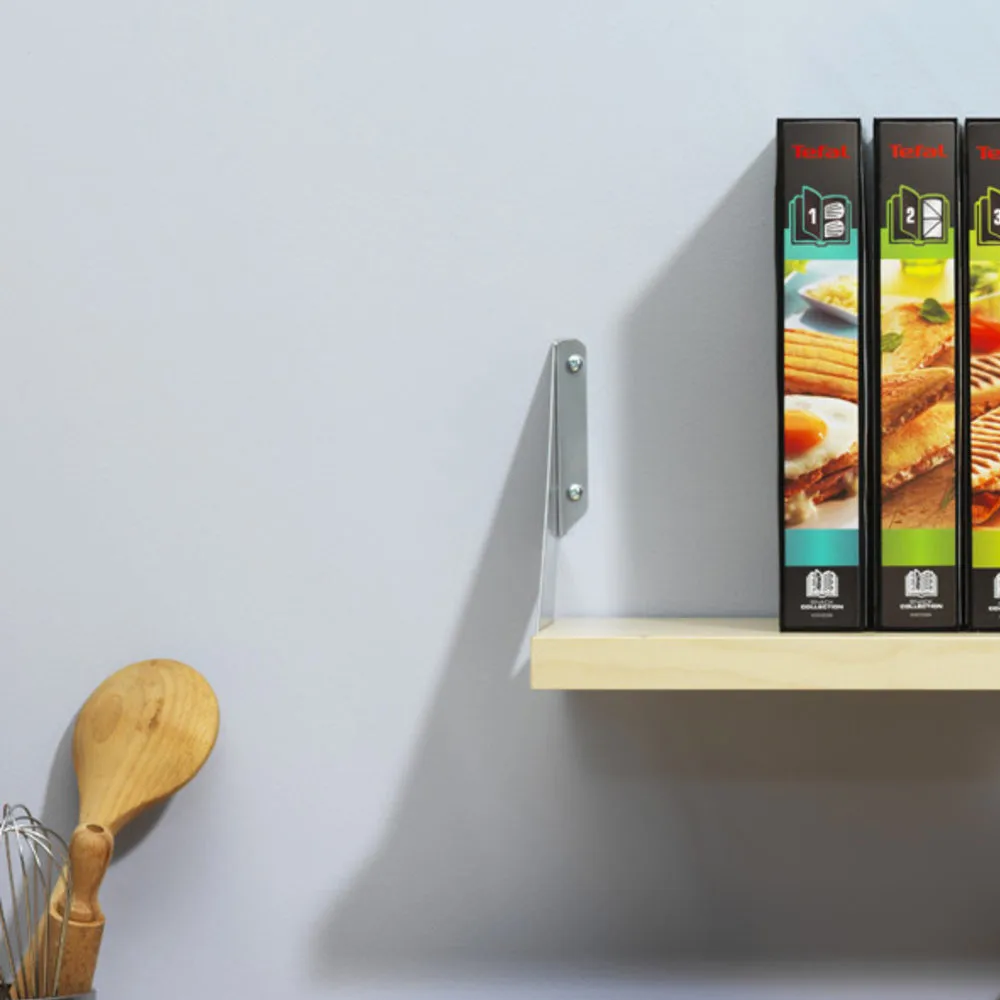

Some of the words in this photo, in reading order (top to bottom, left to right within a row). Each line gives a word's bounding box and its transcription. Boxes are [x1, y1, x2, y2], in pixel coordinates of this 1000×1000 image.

[791, 143, 851, 159] Tefal
[888, 143, 948, 158] Tefal
[808, 207, 817, 225] 1
[905, 206, 915, 224] 2
